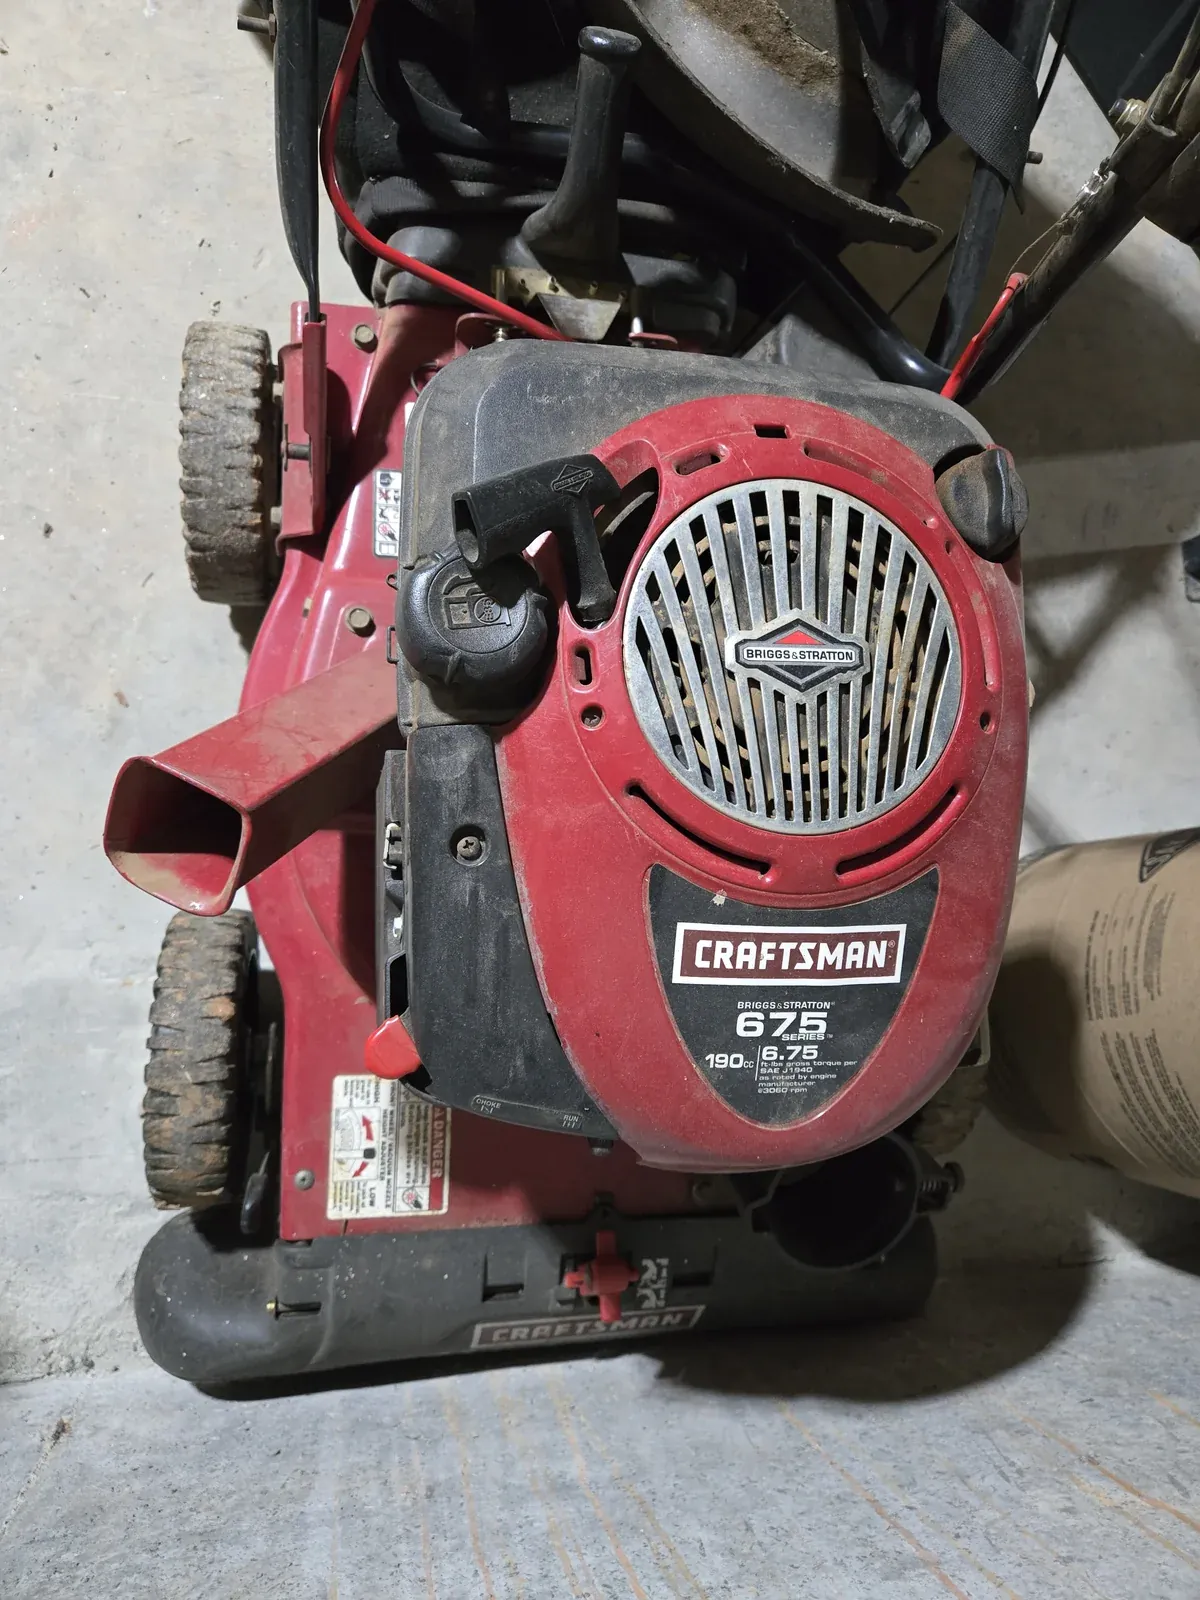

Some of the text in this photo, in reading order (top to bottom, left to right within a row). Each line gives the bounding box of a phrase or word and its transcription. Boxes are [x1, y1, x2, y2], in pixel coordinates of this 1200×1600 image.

[736, 1011, 828, 1037] 675
[761, 1045, 818, 1061] 6.75
[782, 1066, 813, 1074] J1940
[810, 1072, 837, 1080] engine
[790, 1086, 808, 1094] rpm
[476, 1098, 501, 1109] CHOKE
[563, 1114, 579, 1122] RUN
[432, 1119, 444, 1178] DANGER
[492, 1312, 683, 1342] CRAFTSMAN
